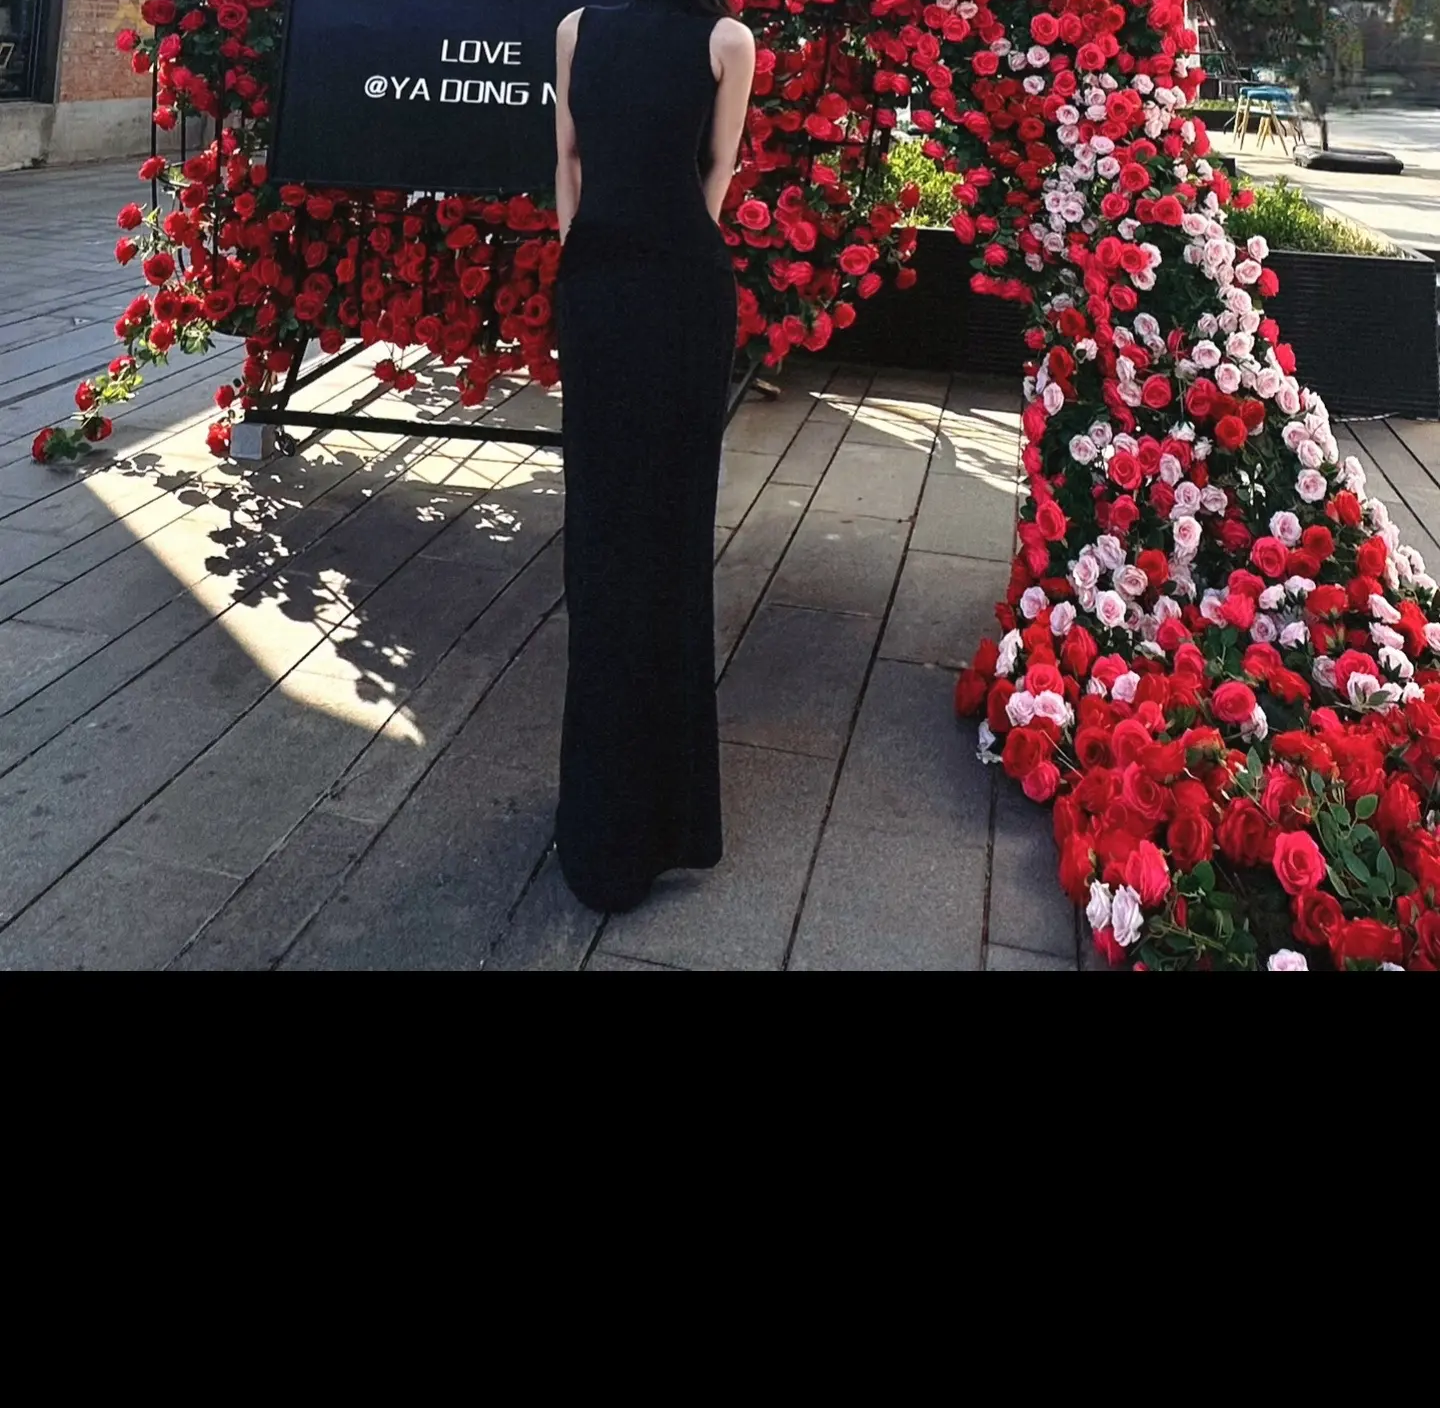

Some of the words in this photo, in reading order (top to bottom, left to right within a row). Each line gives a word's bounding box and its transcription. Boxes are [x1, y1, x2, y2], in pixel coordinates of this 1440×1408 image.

[441, 39, 522, 65] LOVE
[364, 75, 431, 101] @YA
[440, 79, 530, 106] DONG
